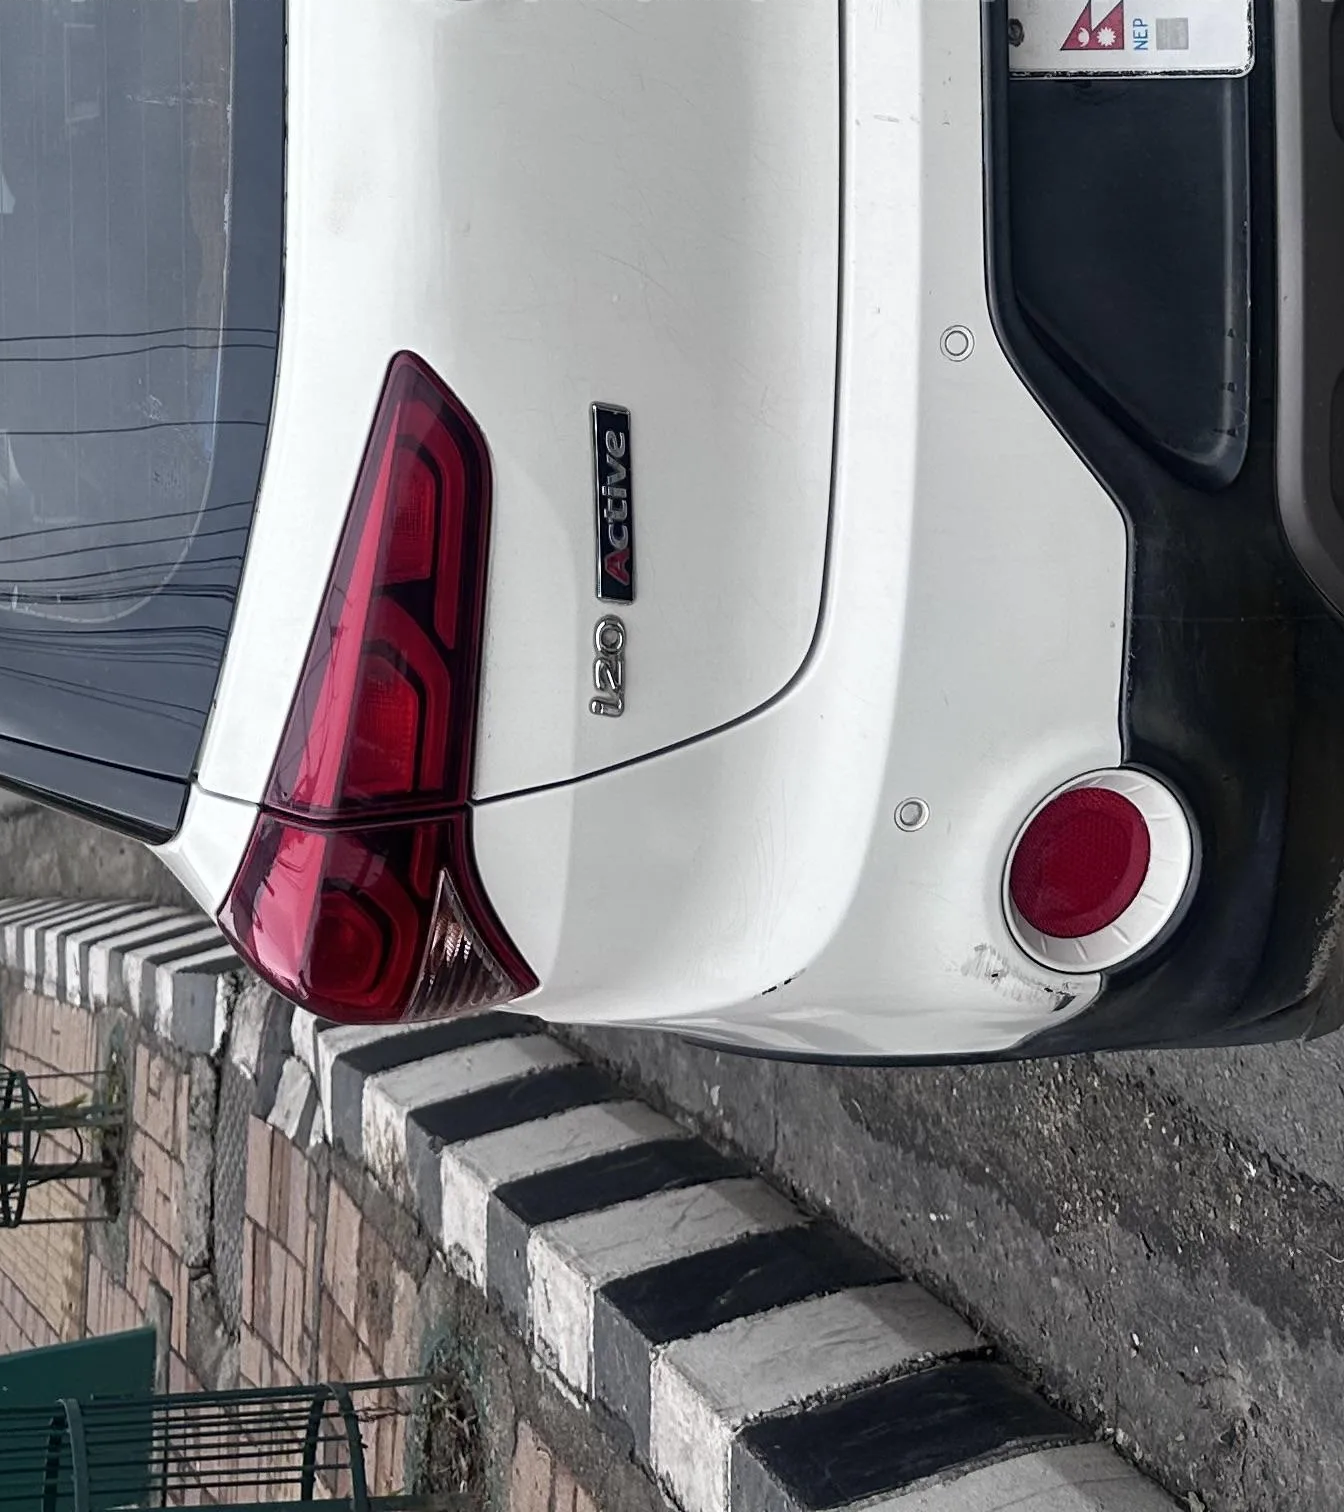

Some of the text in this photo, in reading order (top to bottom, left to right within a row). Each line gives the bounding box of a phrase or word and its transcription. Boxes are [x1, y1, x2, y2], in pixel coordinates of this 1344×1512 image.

[1133, 18, 1148, 50] NEP
[589, 430, 631, 718] i20 Active
